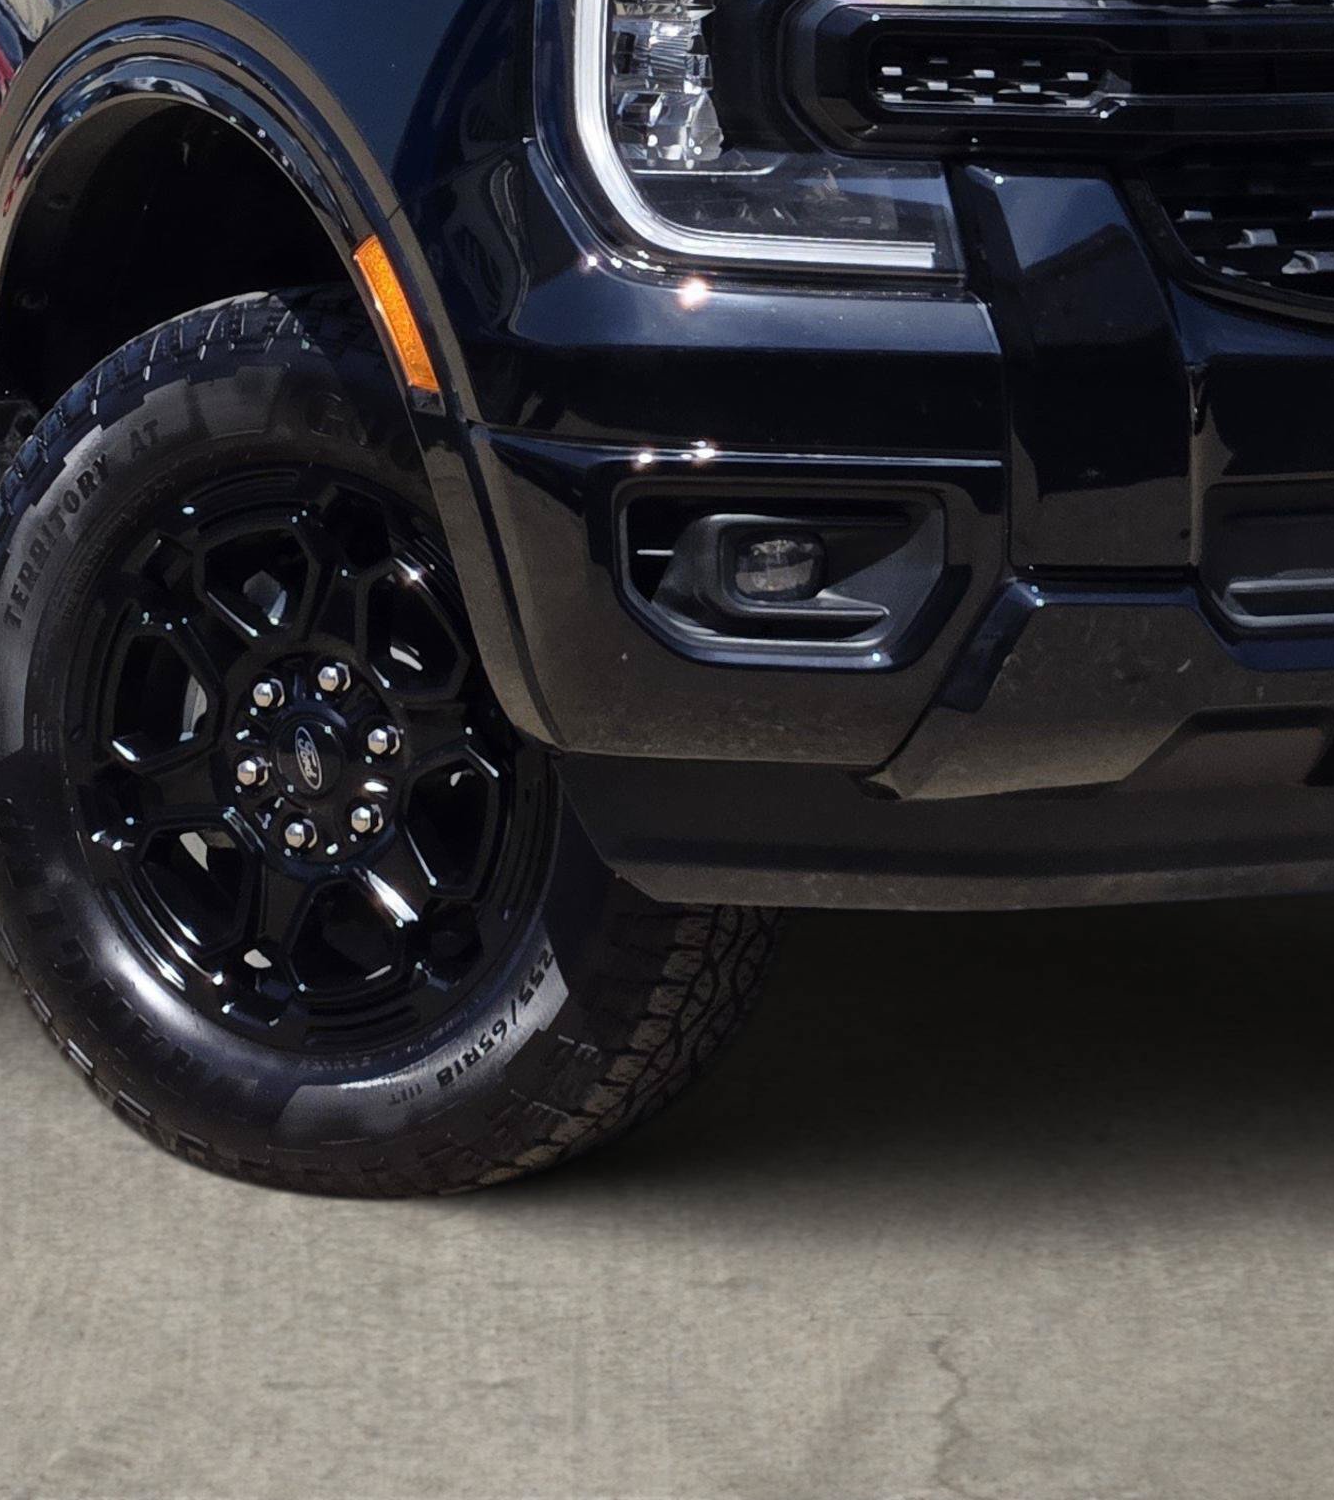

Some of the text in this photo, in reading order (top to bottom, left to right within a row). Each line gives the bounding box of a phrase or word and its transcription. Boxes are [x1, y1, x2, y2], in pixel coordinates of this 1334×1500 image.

[3, 453, 109, 629] TERRITORY
[127, 418, 159, 459] AT
[436, 949, 556, 1088] 255/65R18
